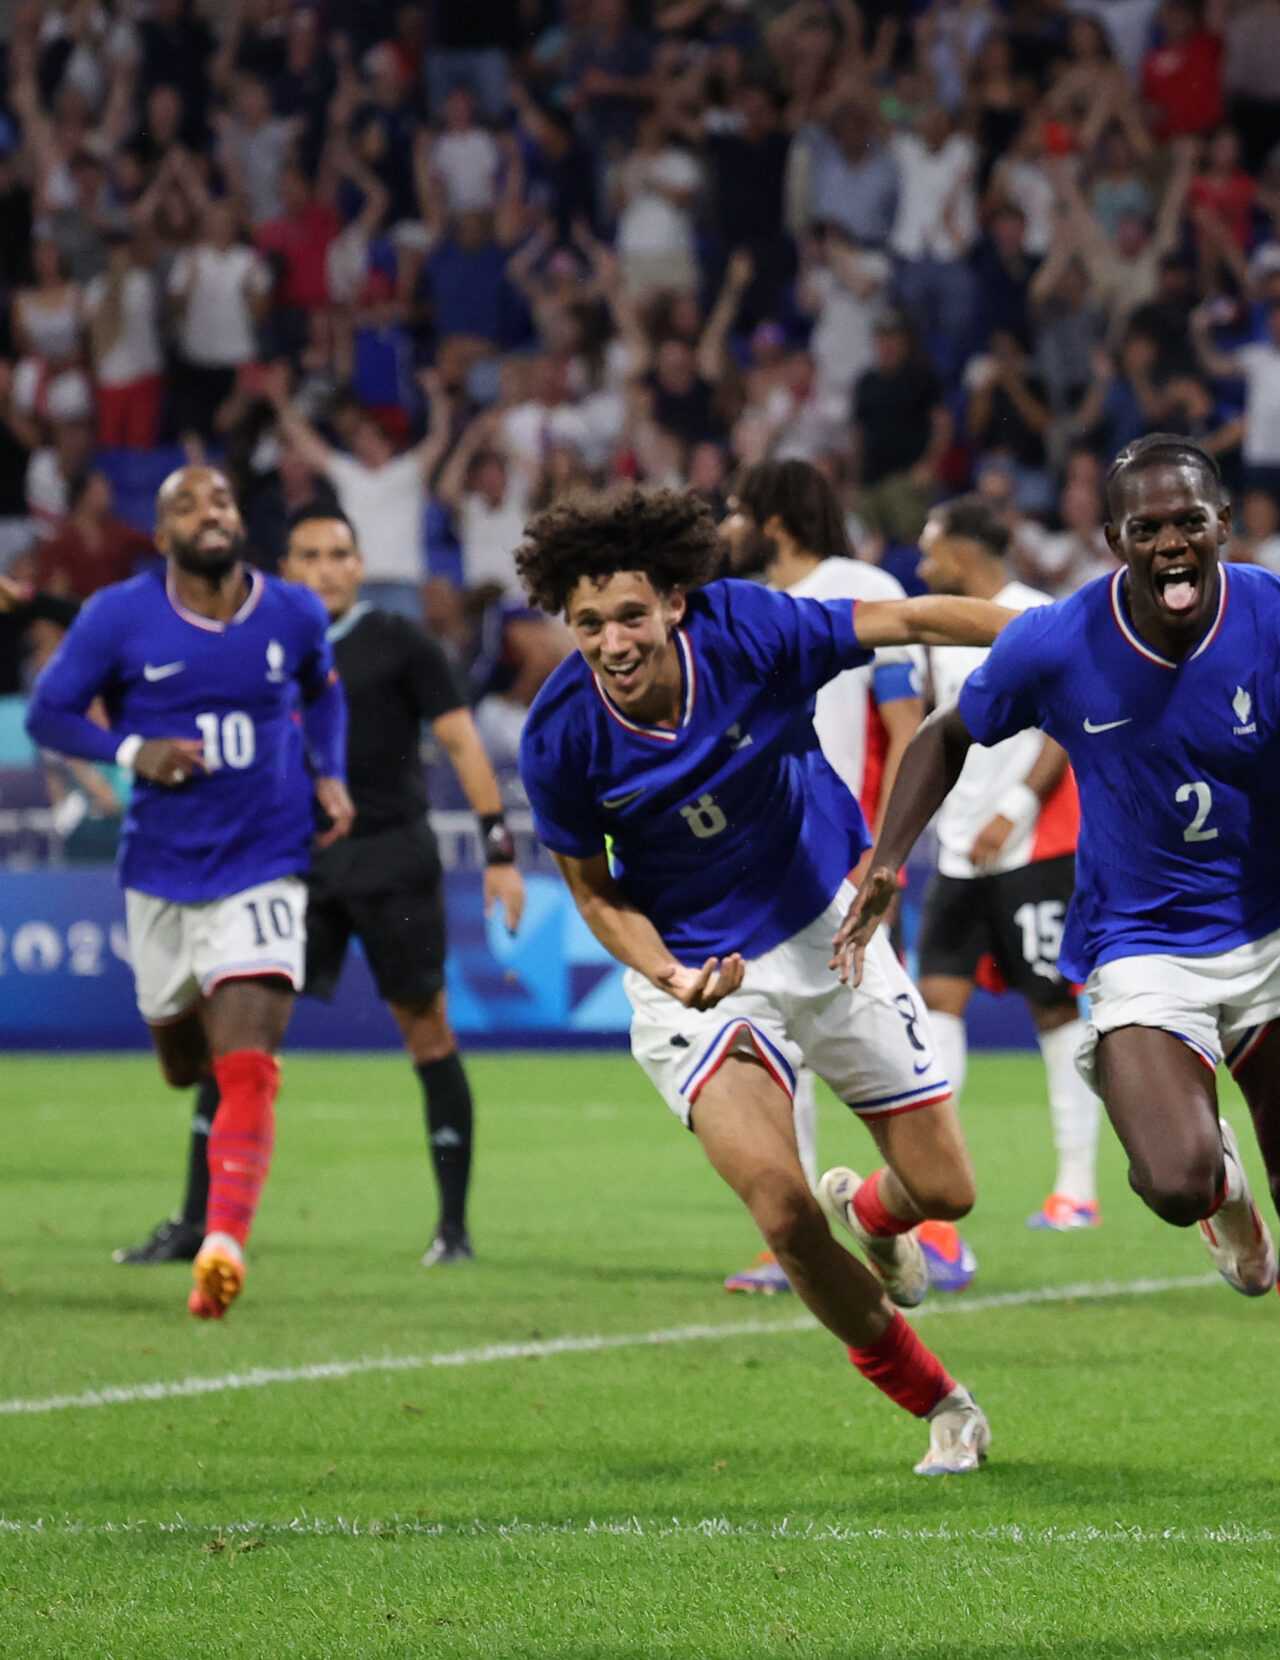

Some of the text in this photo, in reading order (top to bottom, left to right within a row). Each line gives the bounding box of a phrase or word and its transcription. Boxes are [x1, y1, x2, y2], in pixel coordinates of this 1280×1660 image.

[195, 710, 256, 769] 10
[1175, 781, 1218, 842] 2
[244, 898, 293, 946] 10
[1014, 900, 1065, 963] 15
